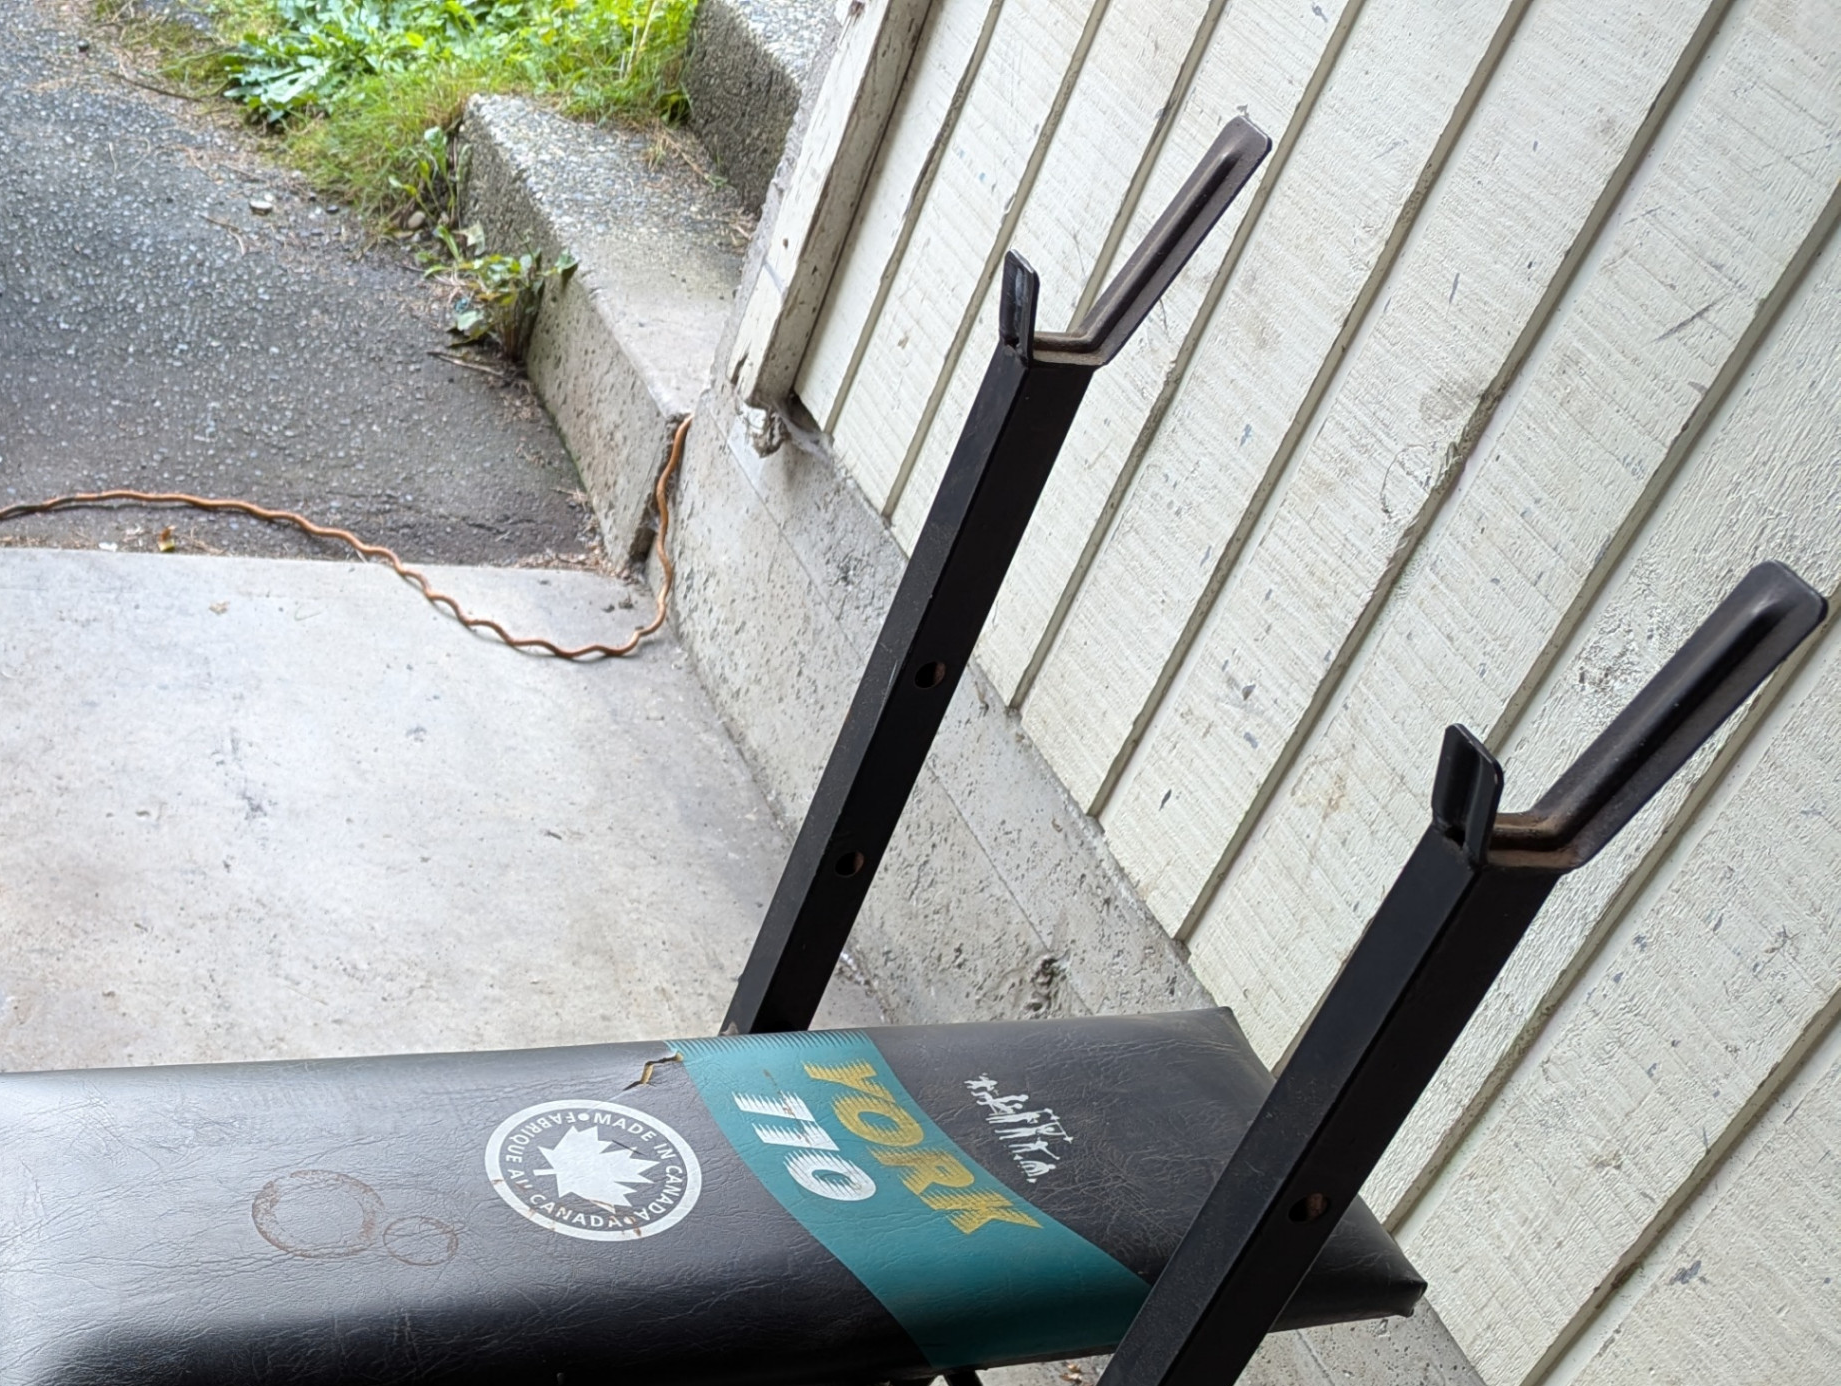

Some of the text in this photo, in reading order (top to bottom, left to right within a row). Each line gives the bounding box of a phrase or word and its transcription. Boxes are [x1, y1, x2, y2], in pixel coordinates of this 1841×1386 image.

[505, 1111, 577, 1164] FABRIQUE
[593, 1111, 684, 1222] MADE IN CANADA
[802, 1057, 1045, 1235] YORK
[529, 1193, 623, 1228] CANADA
